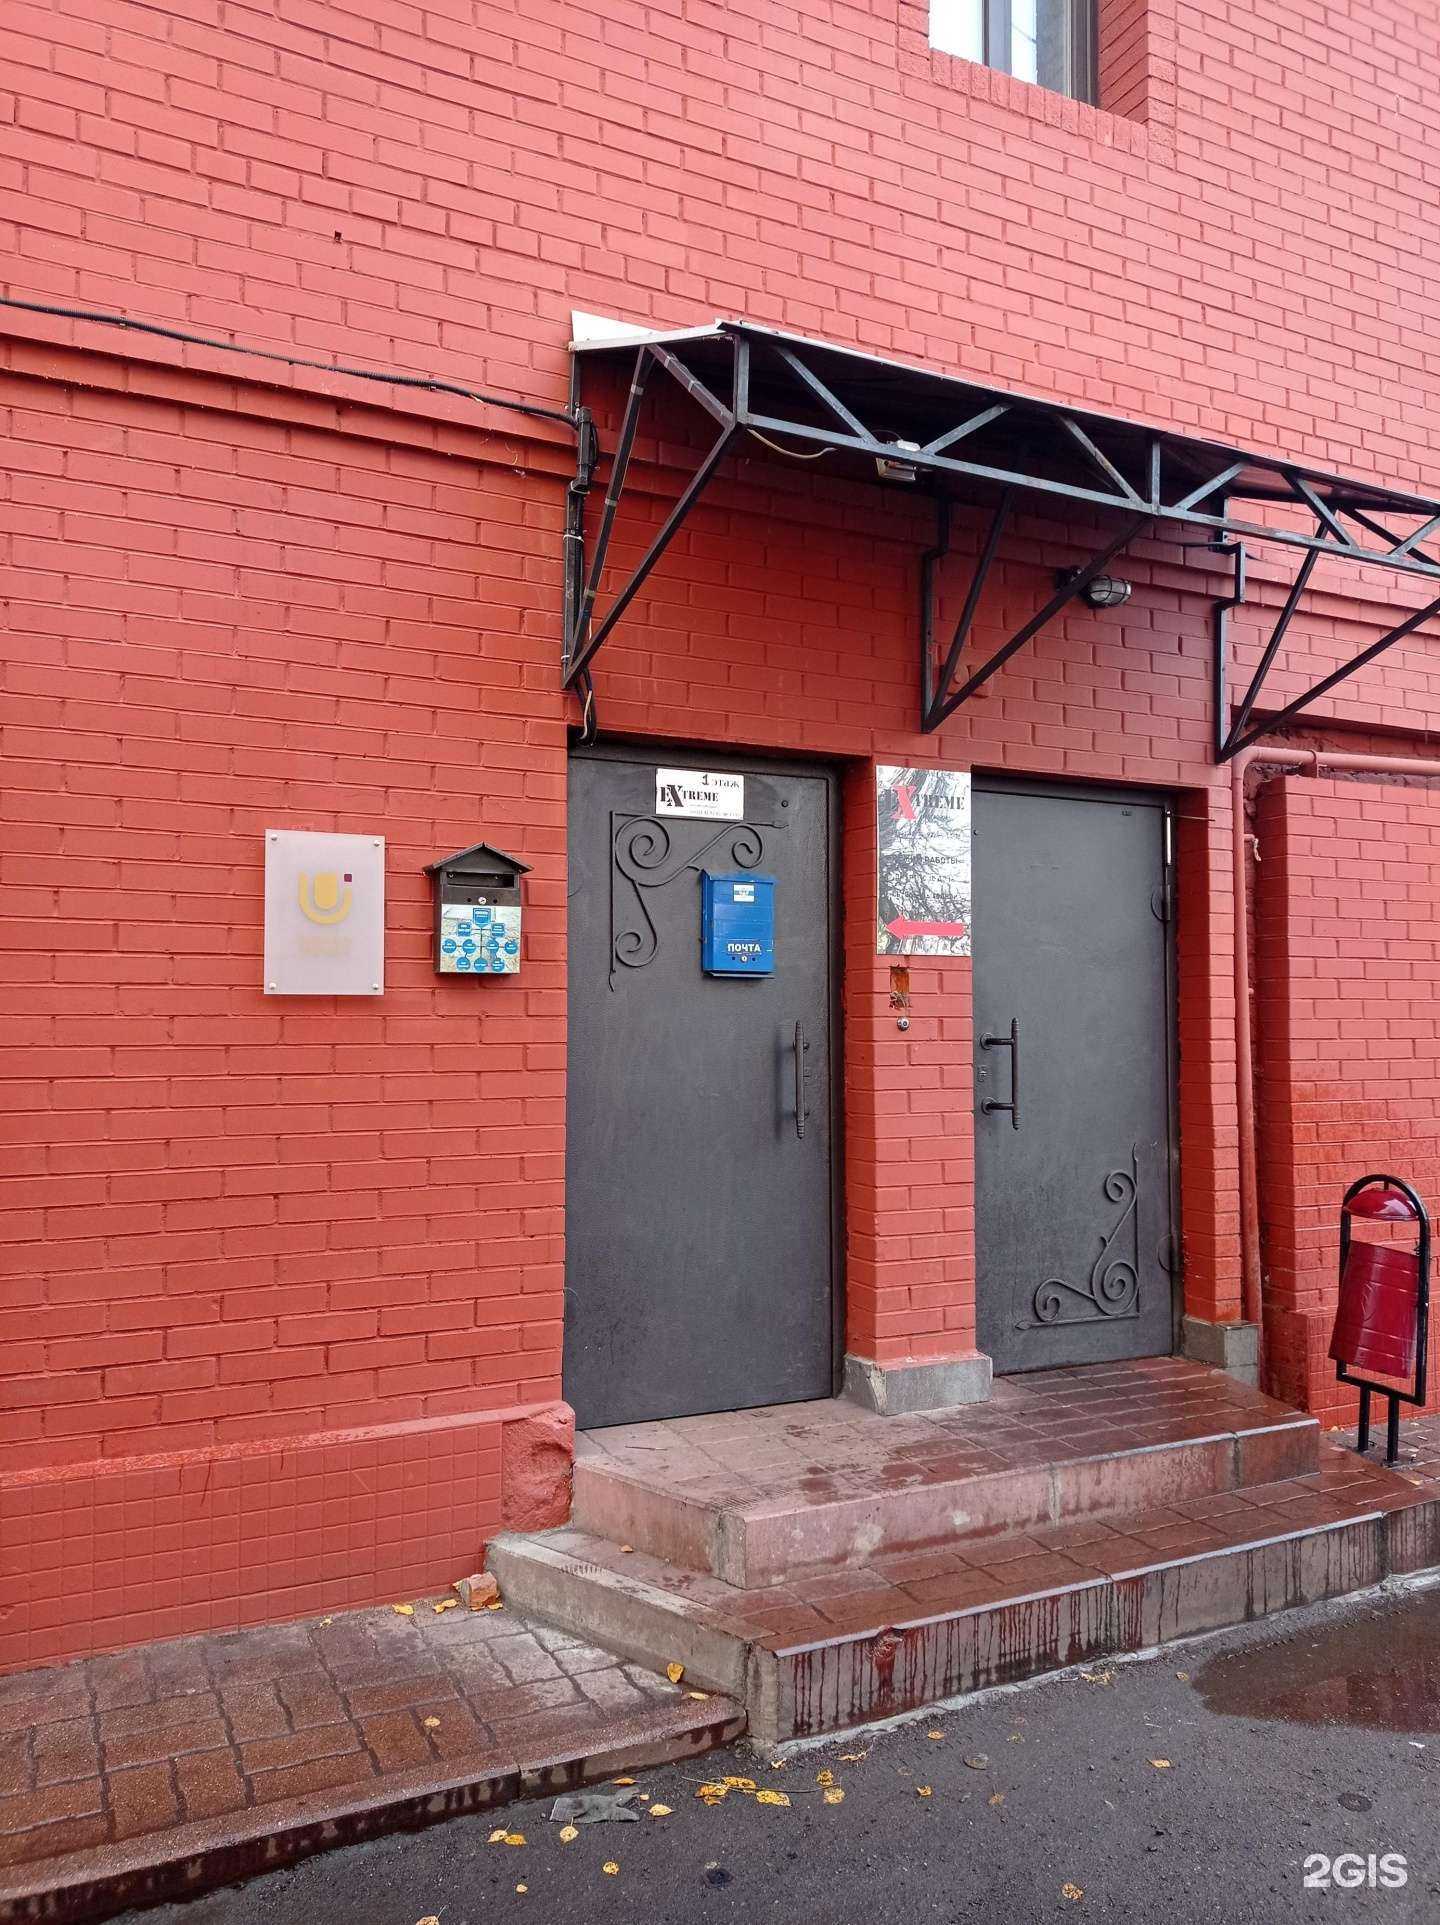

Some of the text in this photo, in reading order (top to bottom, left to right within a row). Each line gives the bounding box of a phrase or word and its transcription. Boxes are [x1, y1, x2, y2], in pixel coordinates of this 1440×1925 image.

[701, 773, 710, 786] 1
[660, 784, 719, 808] EXTREME
[727, 943, 761, 952] ПОЧТА
